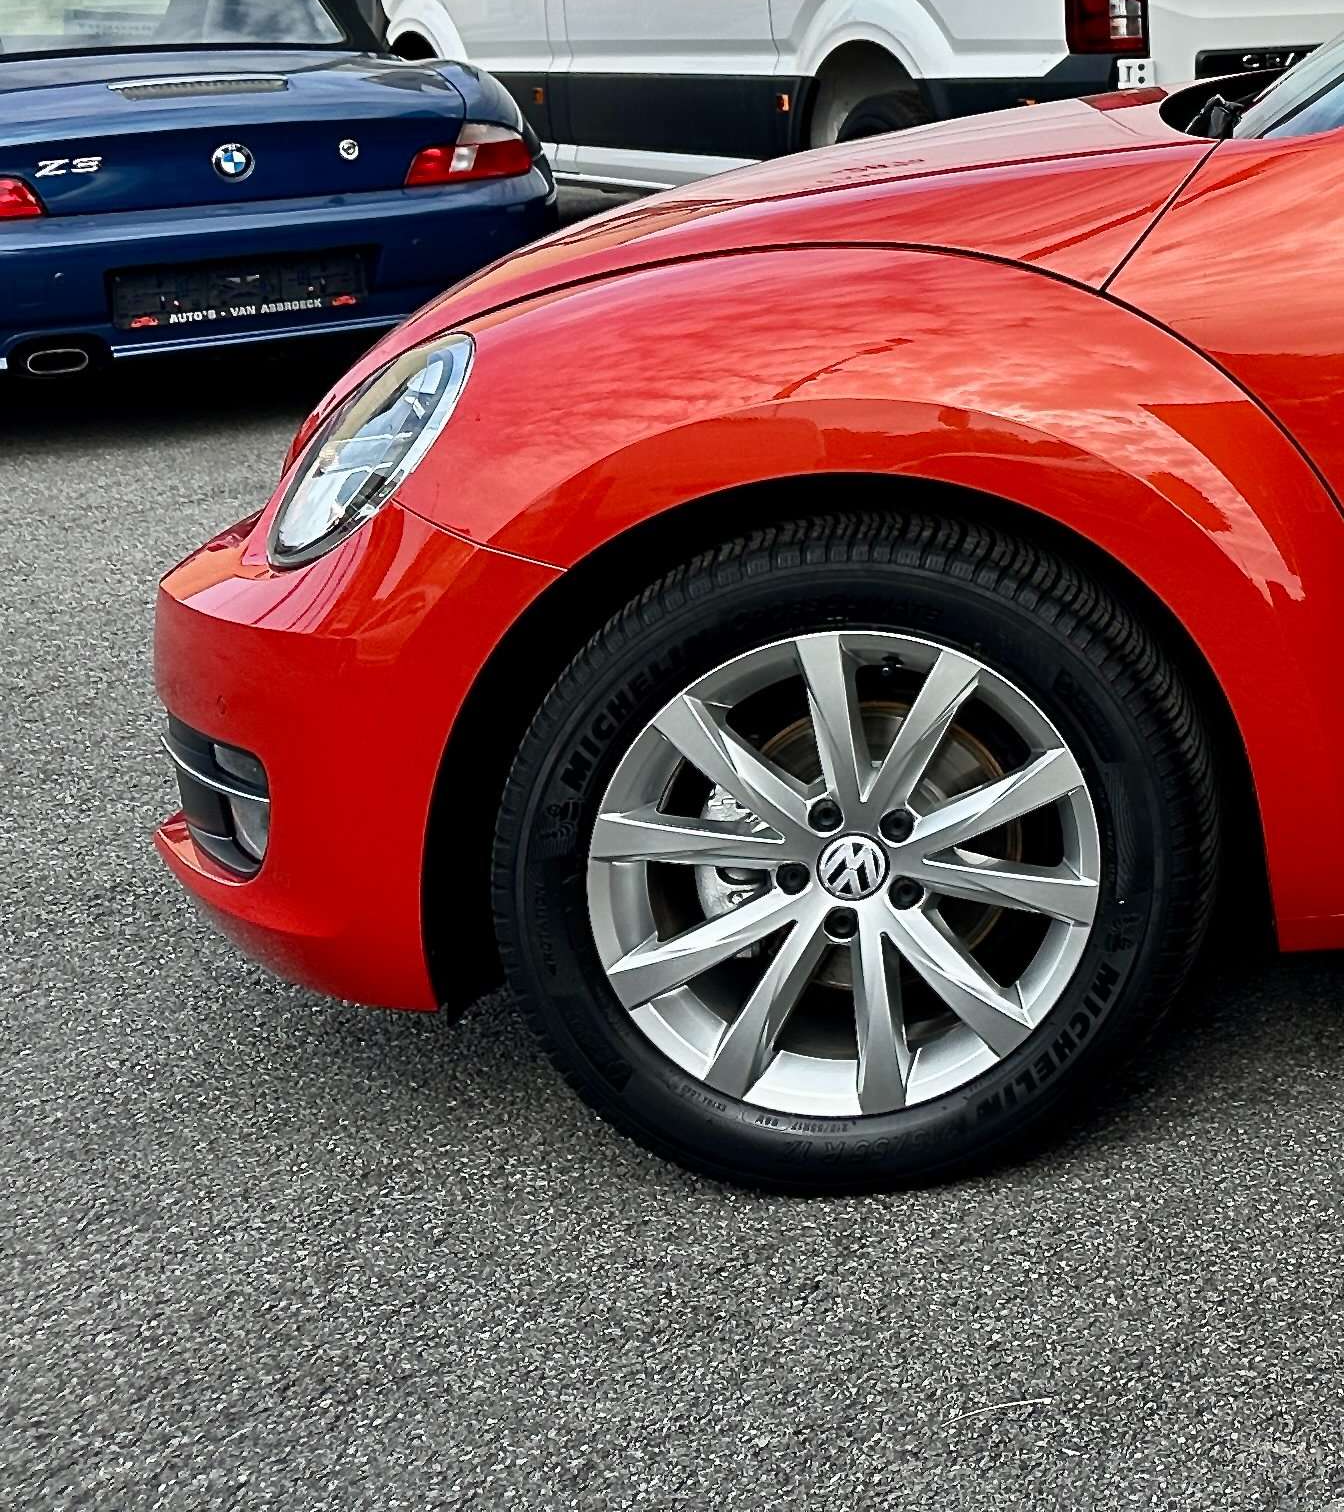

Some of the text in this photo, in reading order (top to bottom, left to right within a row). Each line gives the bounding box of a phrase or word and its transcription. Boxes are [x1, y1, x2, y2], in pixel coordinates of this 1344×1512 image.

[35, 156, 102, 178] Z3
[169, 309, 216, 324] AUTO'S
[230, 304, 256, 317] VAN
[560, 642, 700, 795] MICHELI
